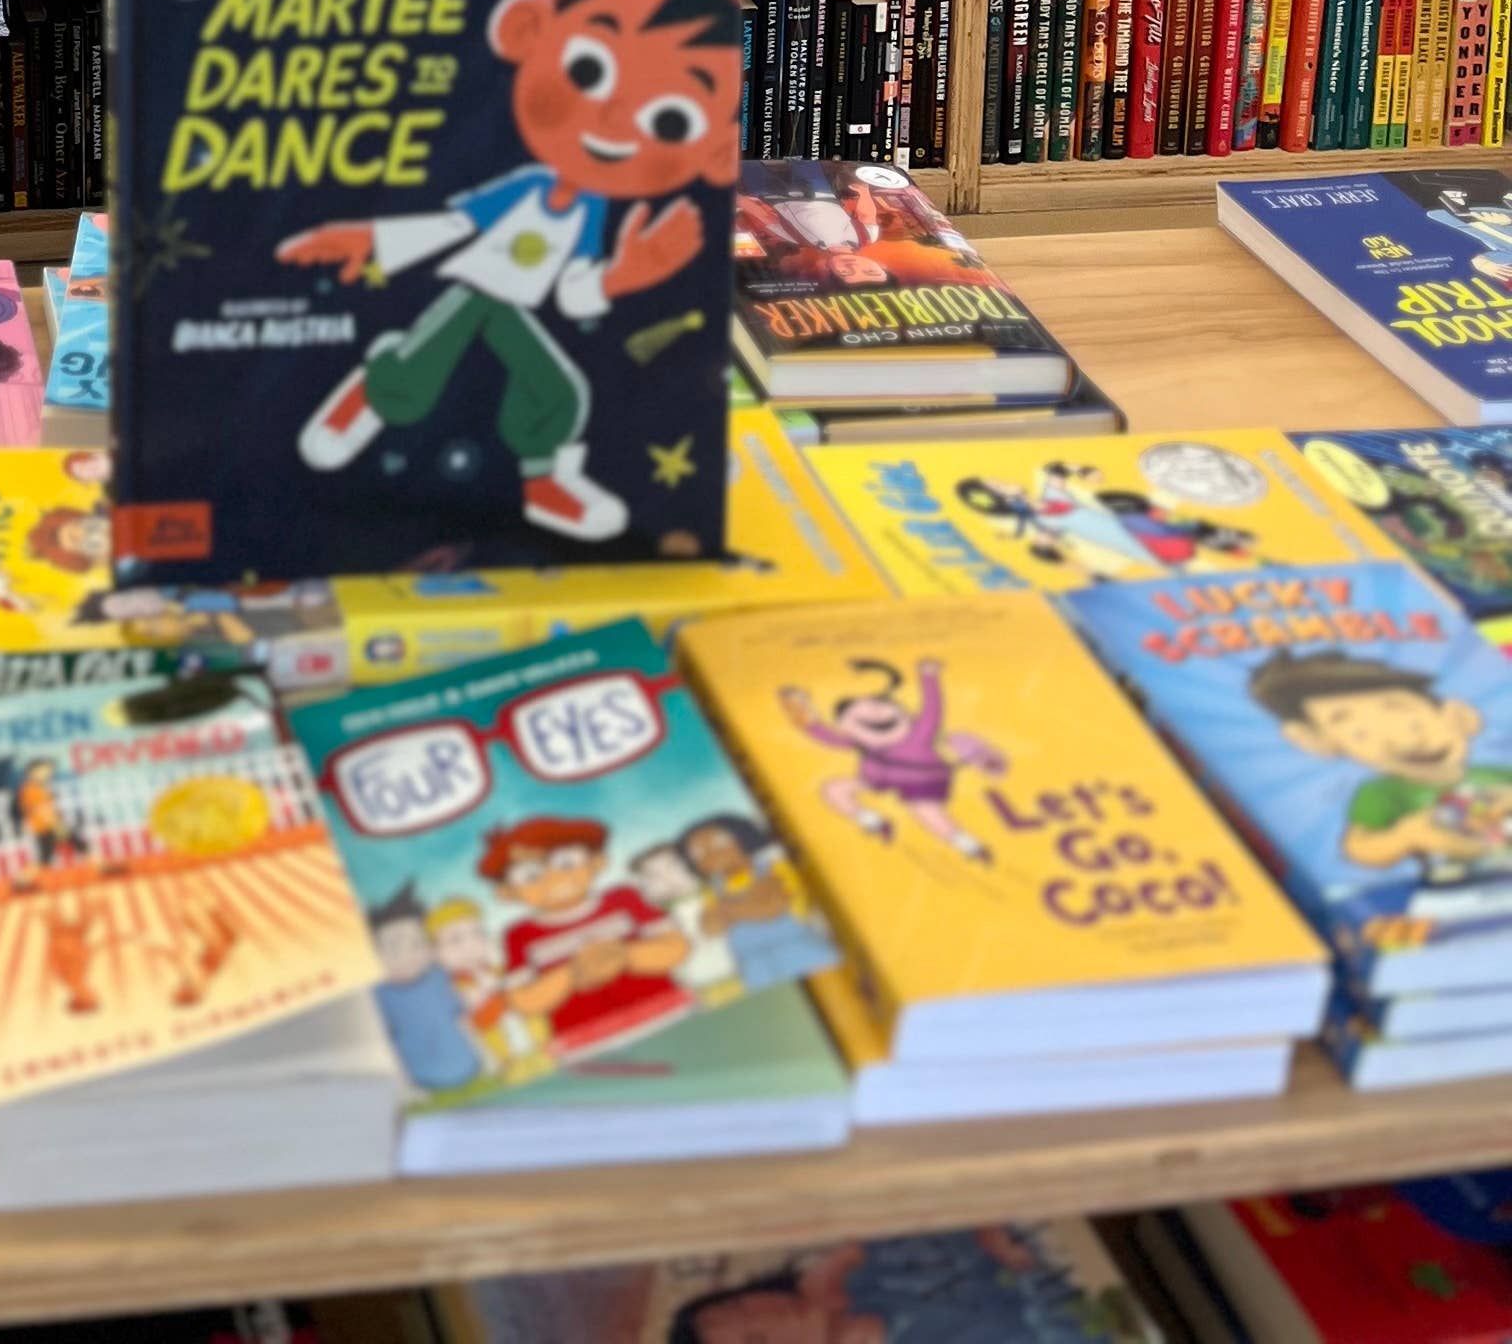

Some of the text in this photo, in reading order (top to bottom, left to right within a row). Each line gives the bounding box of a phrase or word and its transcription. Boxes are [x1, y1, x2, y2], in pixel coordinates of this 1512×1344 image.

[185, 42, 458, 110] DARES TO
[1454, 6, 1472, 118] YONDER
[162, 110, 444, 193] DANCE
[1264, 188, 1380, 209] JERRY CRAFT
[1362, 235, 1395, 249] KID
[1369, 243, 1412, 260] NEW
[752, 285, 1028, 340] TROUBLEMAKER
[1397, 276, 1512, 316] TRIP
[843, 324, 974, 345] JOHN CHO
[1151, 577, 1354, 624] LUCKY
[1141, 610, 1447, 663] SCRAMBLE
[349, 691, 648, 821] FOUR EYES
